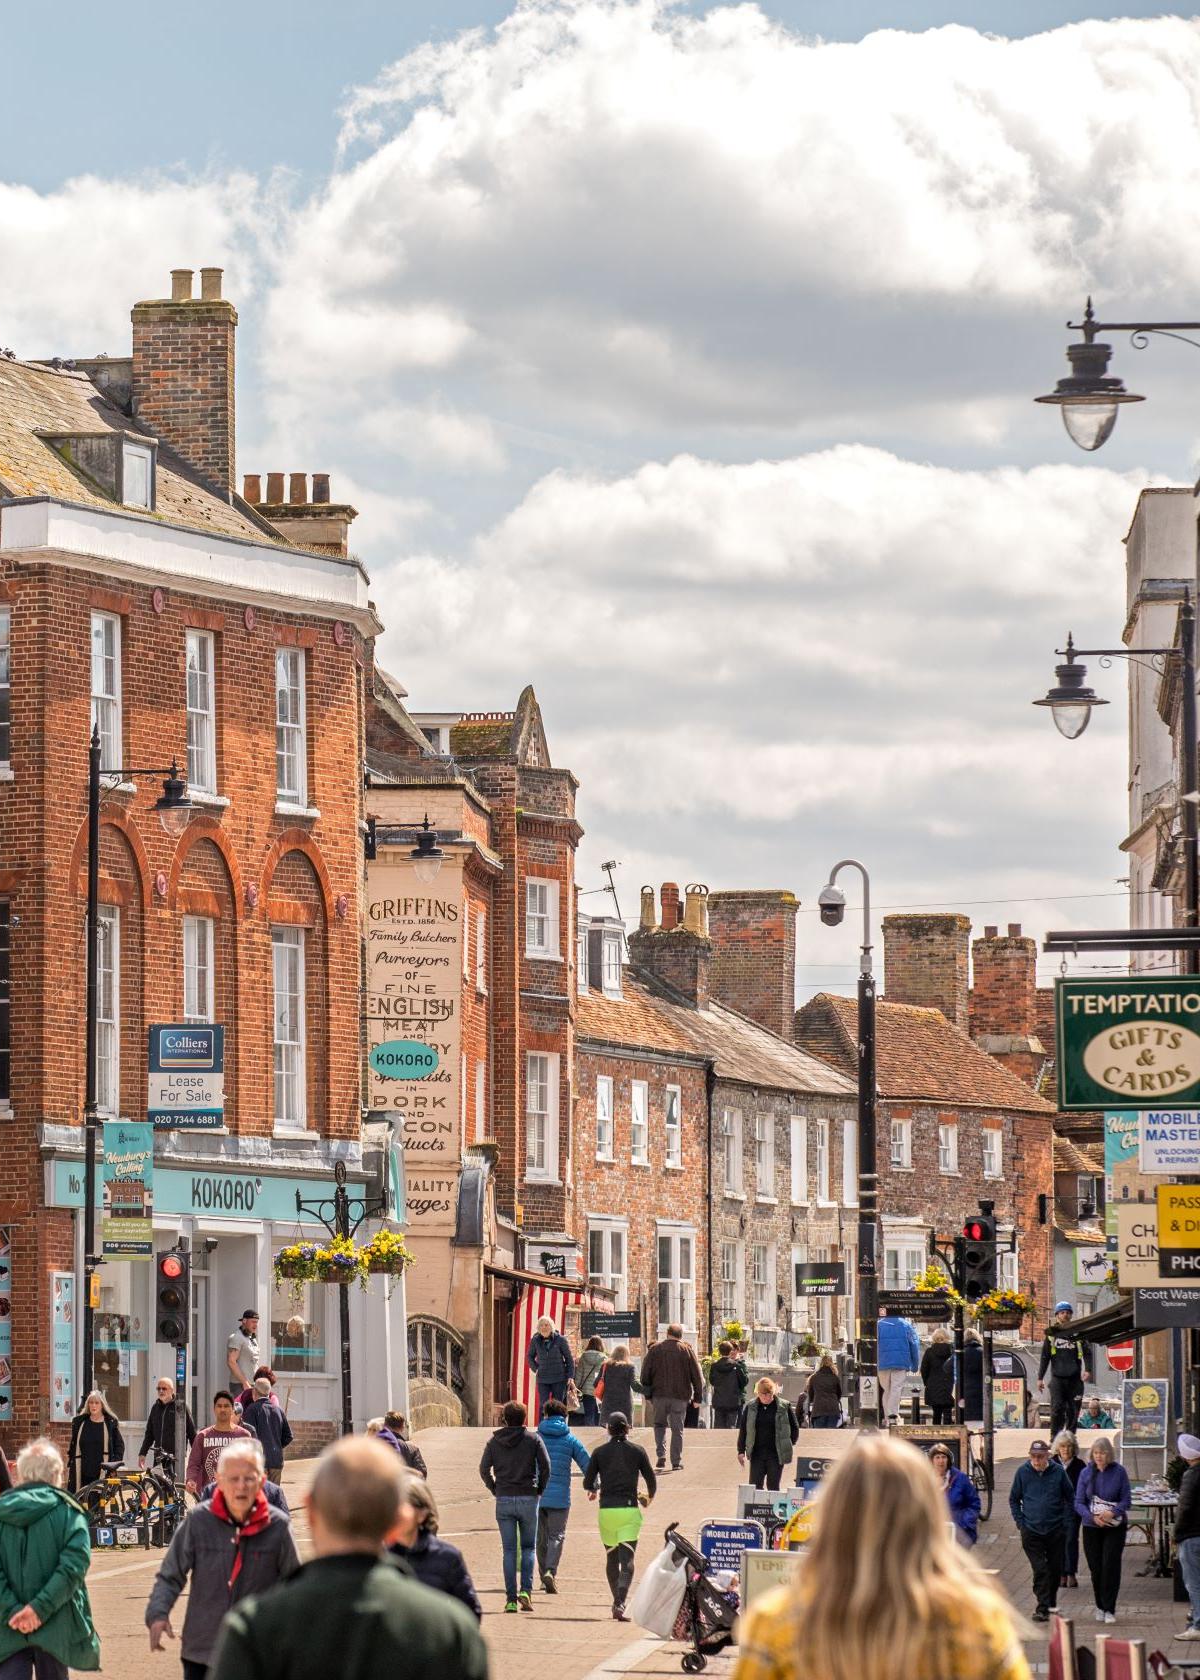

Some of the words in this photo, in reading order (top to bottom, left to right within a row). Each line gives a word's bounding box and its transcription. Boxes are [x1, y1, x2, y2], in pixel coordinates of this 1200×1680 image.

[369, 898, 458, 921] GRIFFINS
[370, 930, 408, 944] Family
[411, 931, 457, 943] Butchers
[375, 951, 450, 968] Purveyors
[405, 972, 418, 980] OF
[385, 984, 436, 994] FINE
[369, 997, 454, 1016] ENGLISH
[1067, 993, 1200, 1014] TEMPTATIO
[385, 1021, 437, 1031] MEAT
[166, 1037, 208, 1048] Colliers
[1109, 1027, 1182, 1050] GIFTS
[376, 1053, 433, 1066] KOKORO
[1136, 1049, 1154, 1066] &
[169, 1075, 204, 1087] Lease
[1103, 1064, 1191, 1091] CARDS
[161, 1090, 181, 1101] For
[186, 1090, 211, 1101] Sale
[374, 1096, 446, 1108] PORK
[1148, 1113, 1200, 1125] MOBIL
[404, 1122, 451, 1133] CON
[1146, 1129, 1200, 1141] MASTE
[402, 1137, 445, 1151] ducts
[105, 1151, 151, 1165] Newbury's
[68, 1174, 80, 1194] No
[407, 1180, 454, 1192] IALITY
[191, 1177, 254, 1211] KOKORO
[1131, 1224, 1158, 1237] CH
[1170, 1220, 1180, 1231] &
[1140, 1288, 1167, 1299] Scott
[1002, 1380, 1019, 1391] BIG
[1135, 1394, 1141, 1404] 3
[1150, 1394, 1157, 1403] 2
[203, 1437, 232, 1447] RAMO
[100, 1529, 110, 1544] P
[706, 1530, 730, 1538] MOBILE
[731, 1531, 755, 1539] MASTER
